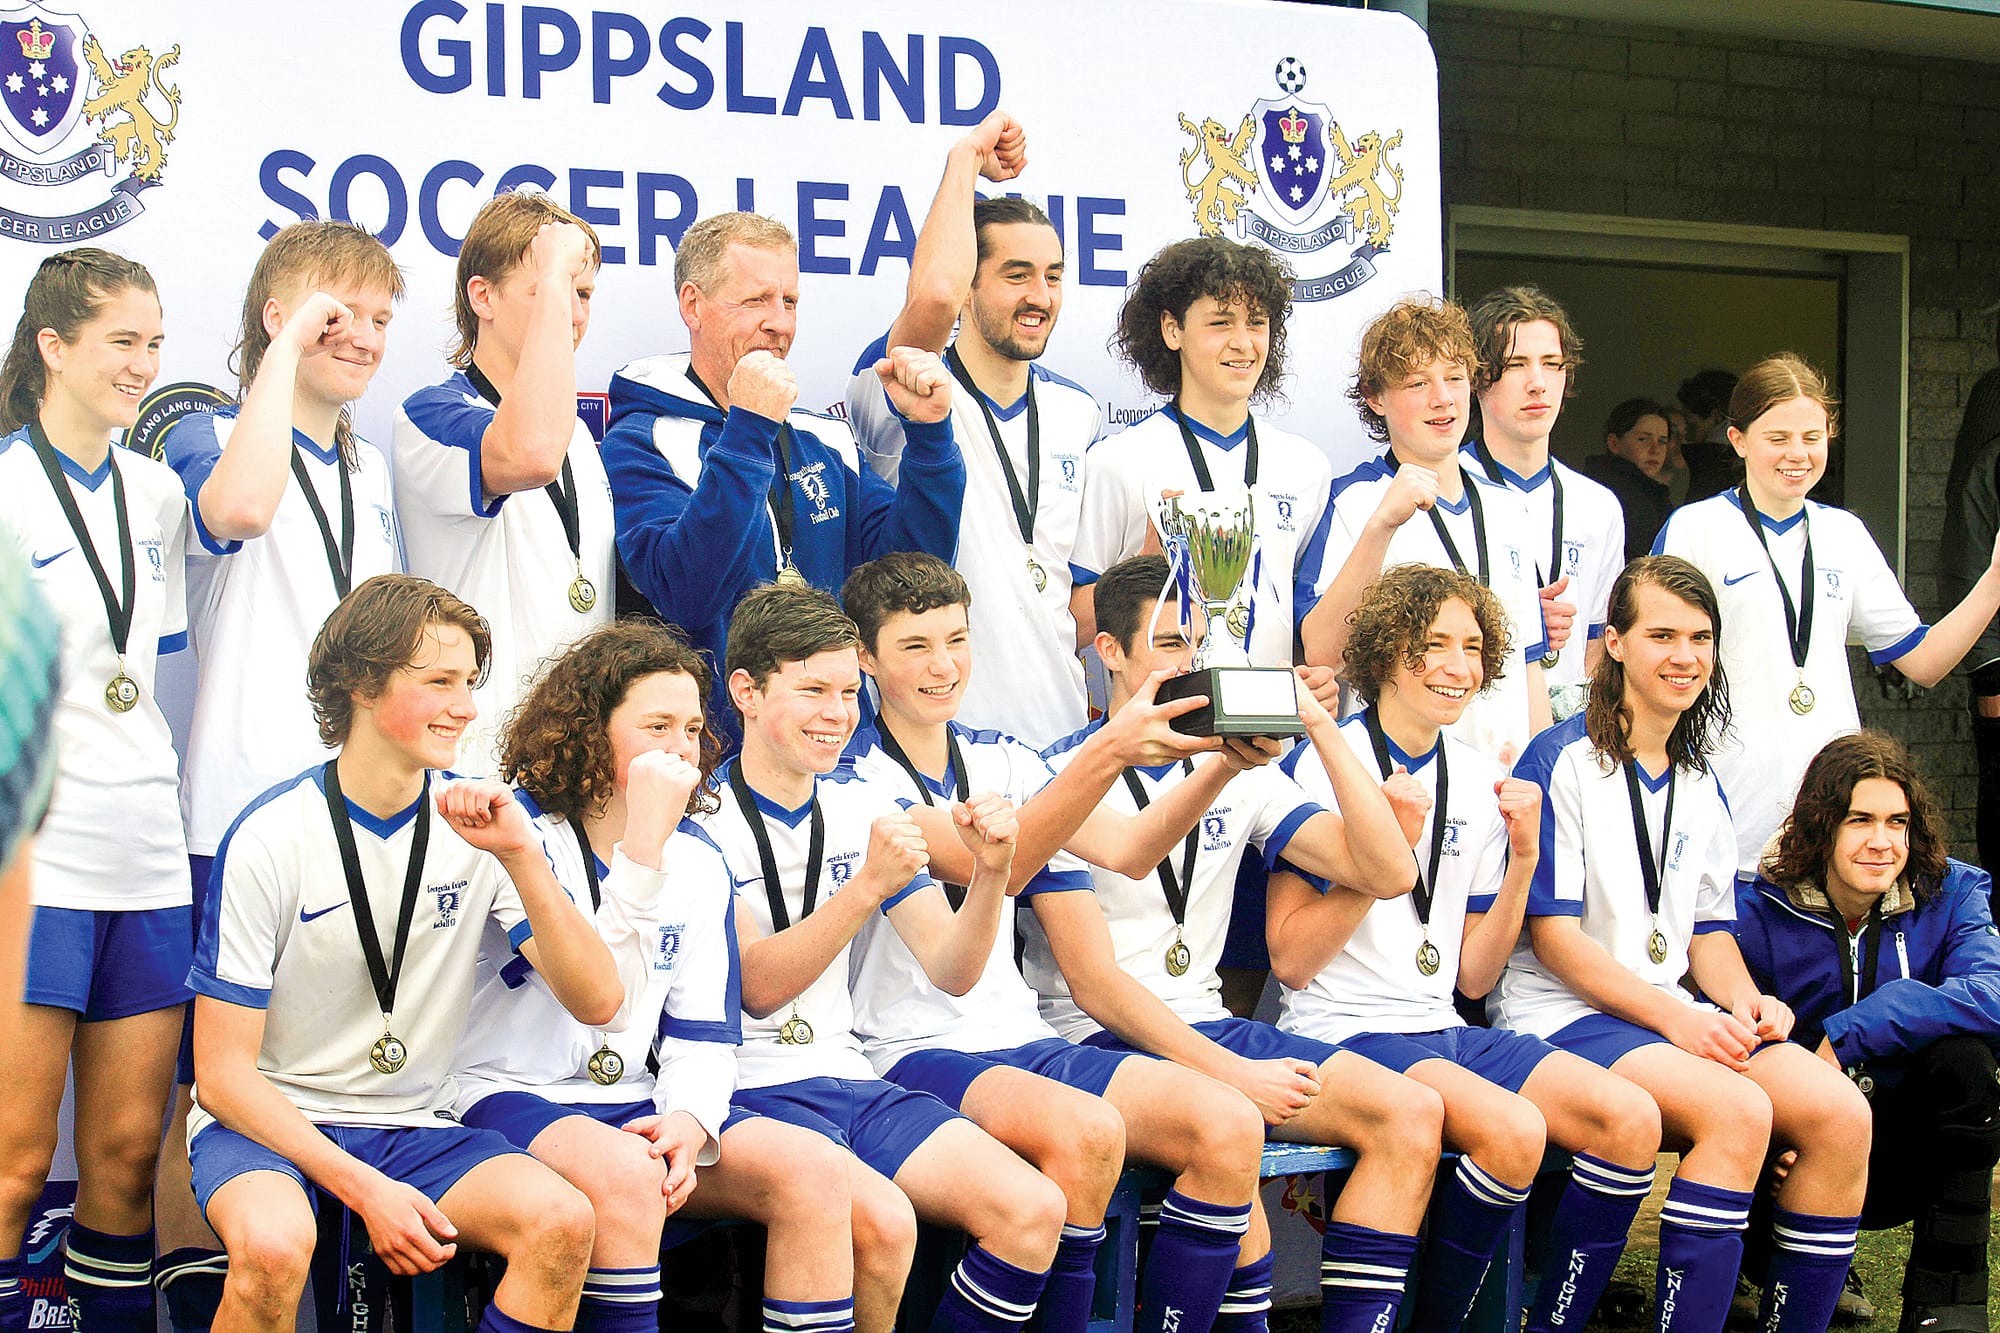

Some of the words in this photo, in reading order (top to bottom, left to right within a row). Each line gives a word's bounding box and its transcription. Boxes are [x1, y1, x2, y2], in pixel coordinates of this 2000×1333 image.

[400, 0, 1001, 126] GIPPSLAND
[48, 200, 132, 240] LEAGUE
[258, 149, 699, 266] SOCER
[736, 178, 1128, 288] EAE
[1252, 221, 1344, 250] GIPPSLAND
[1302, 265, 1367, 299] LEAGUE
[137, 412, 162, 444] LANG
[160, 400, 192, 417] LANG
[580, 402, 599, 410] CITY
[347, 1262, 369, 1333] KNIGH
[1551, 1249, 1589, 1325] KNIGHTS
[67, 1296, 82, 1333] KNI
[1162, 1306, 1184, 1333] KN
